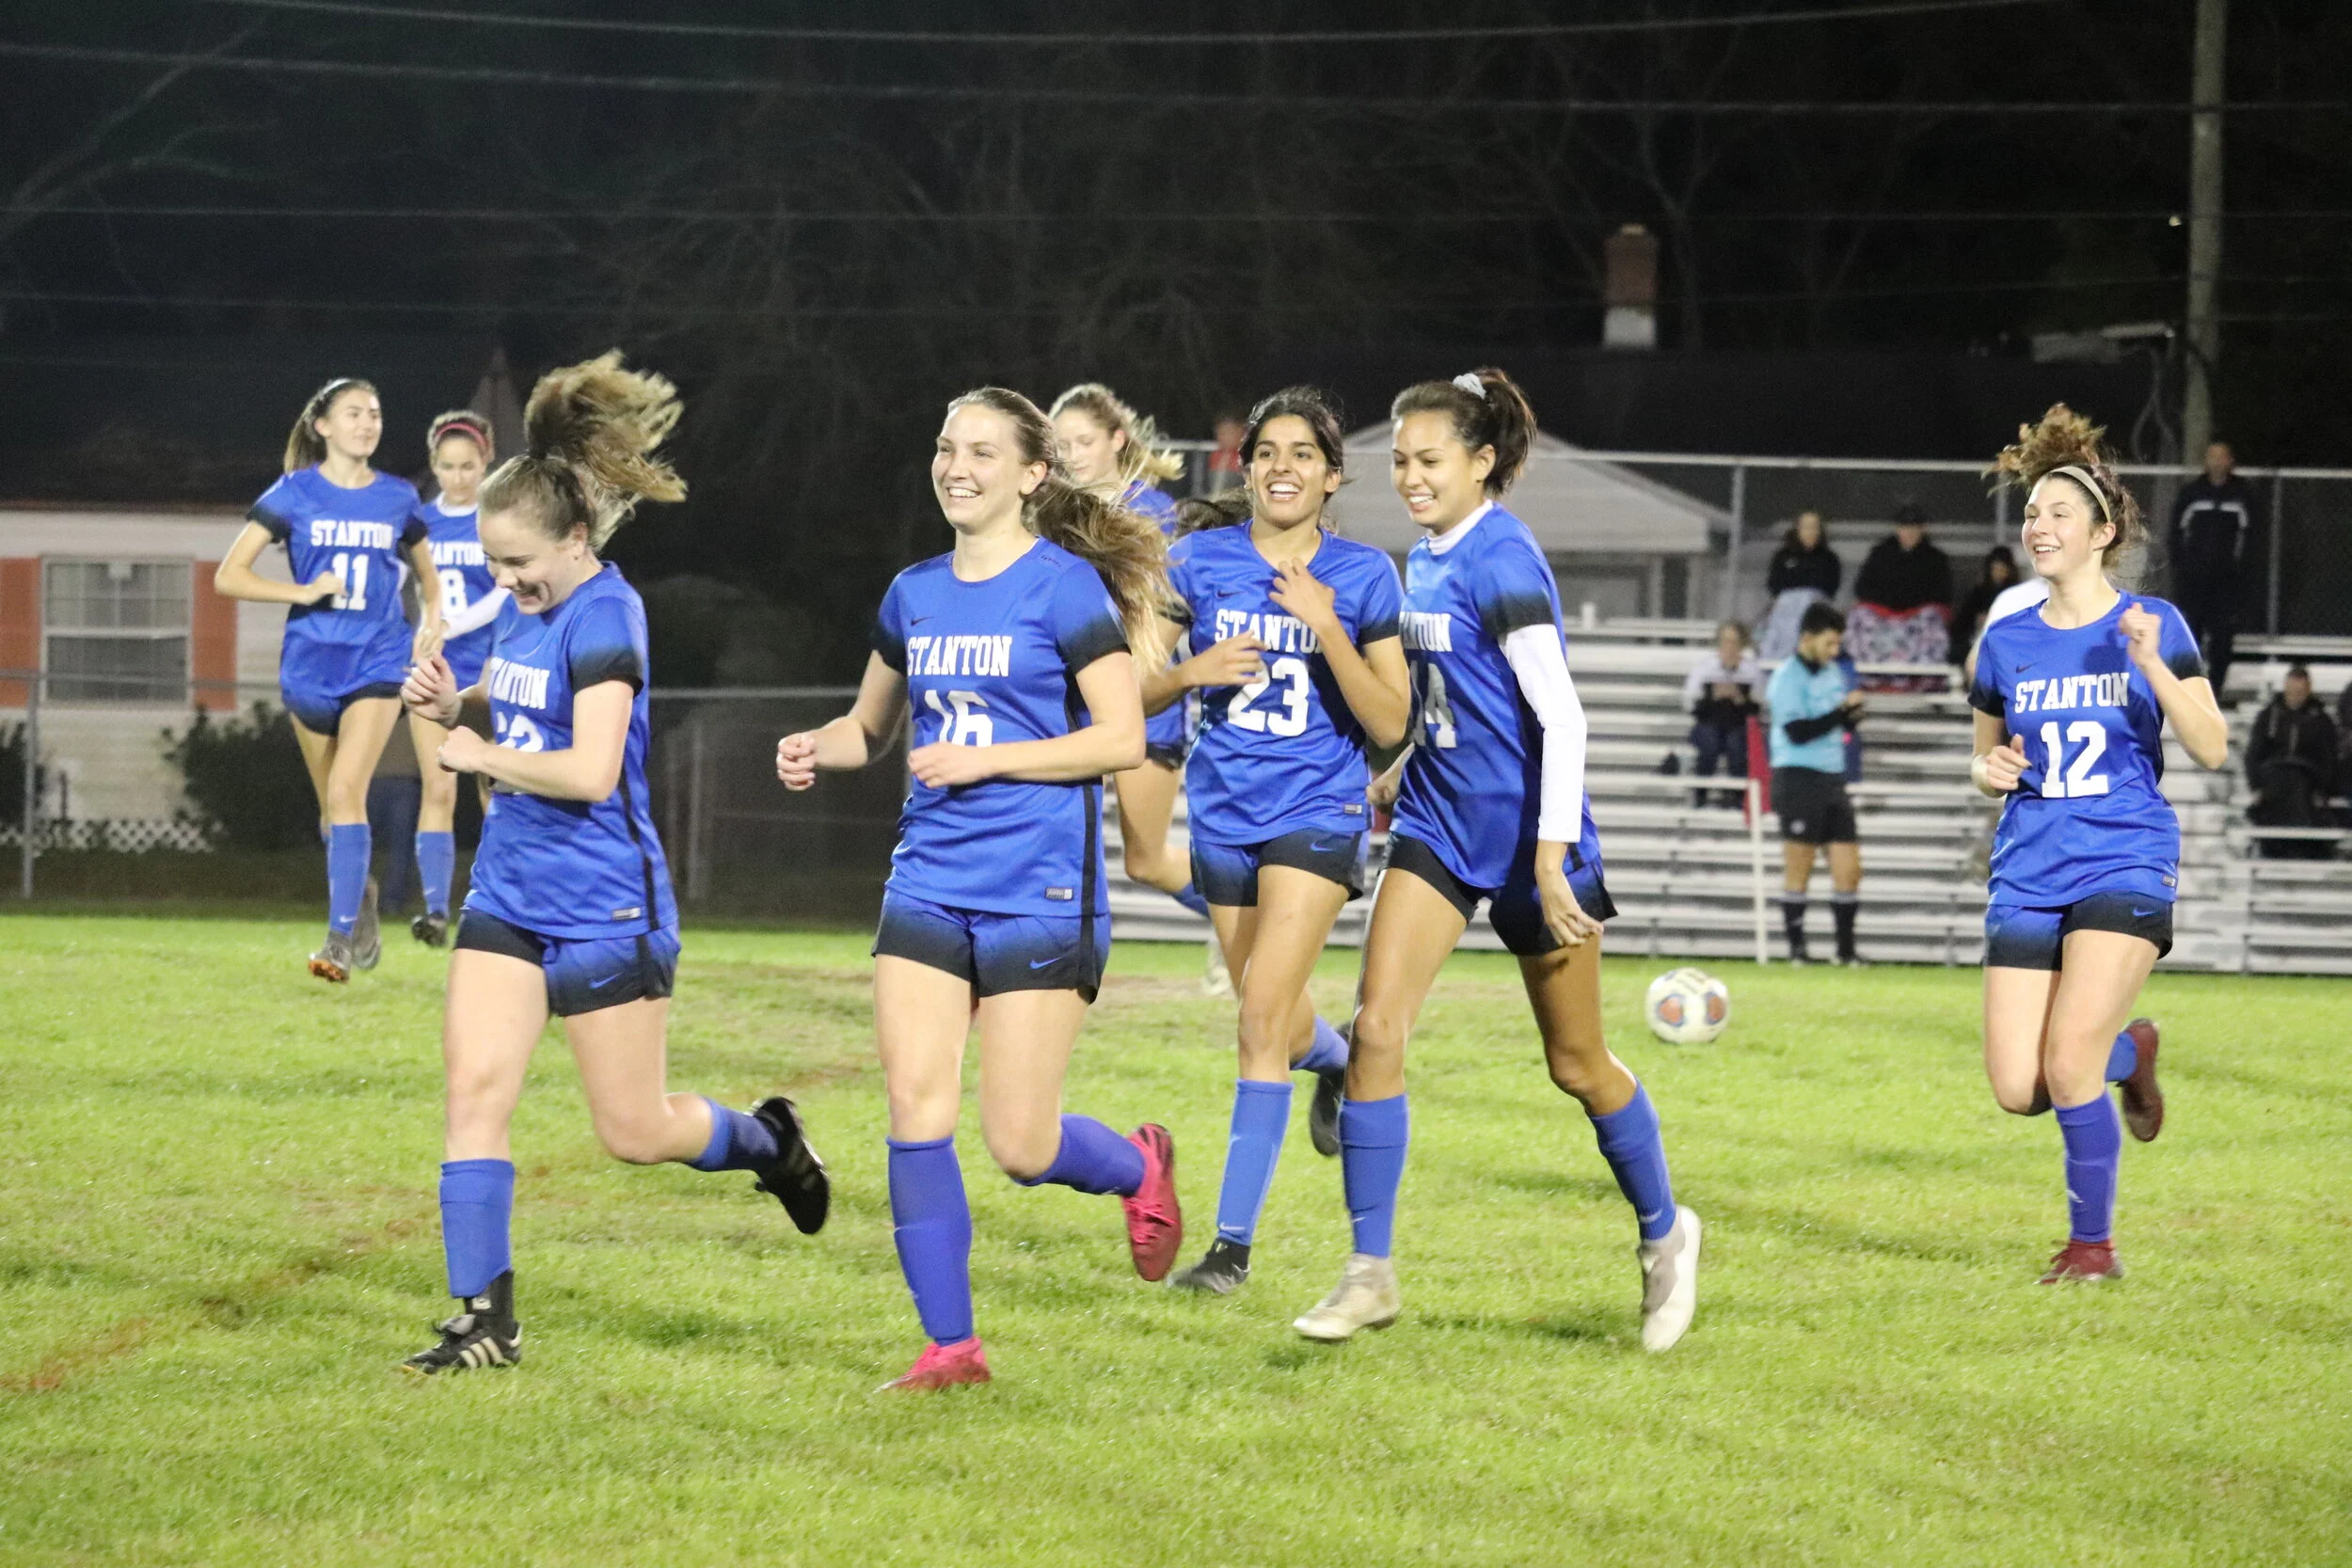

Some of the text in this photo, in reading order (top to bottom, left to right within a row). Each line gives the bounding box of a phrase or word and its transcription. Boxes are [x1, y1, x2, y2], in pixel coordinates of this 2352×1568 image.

[310, 519, 393, 550] STANTON
[331, 551, 370, 611] 11
[439, 568, 469, 617] 8
[908, 635, 1012, 676] STANTON
[1215, 608, 1324, 654] STANTO
[1227, 657, 1310, 737] 23
[2014, 672, 2130, 714] STANTON
[924, 689, 993, 748] 16
[2040, 721, 2109, 799] 12
